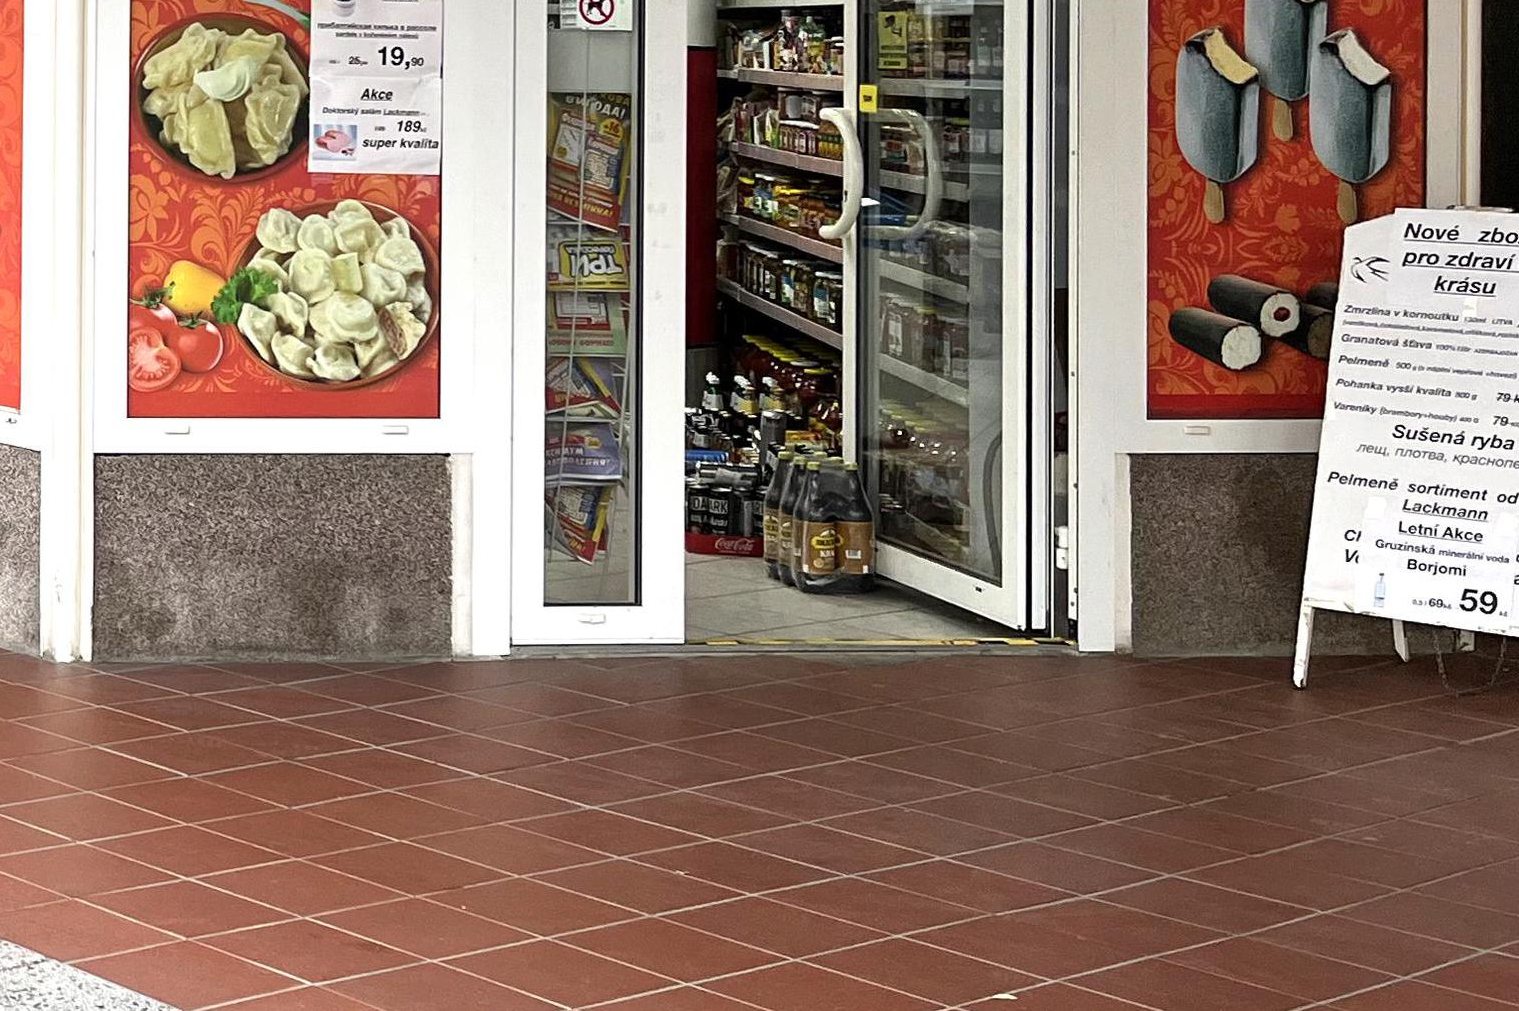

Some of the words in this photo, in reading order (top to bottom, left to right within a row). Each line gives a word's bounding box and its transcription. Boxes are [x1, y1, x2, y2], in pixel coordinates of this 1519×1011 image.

[378, 46, 425, 70] 19,90
[361, 88, 393, 101] Akce
[362, 139, 397, 151] super
[400, 138, 439, 149] kvalita
[1404, 223, 1459, 241] Nové
[1478, 227, 1519, 244] zbo
[1402, 251, 1439, 268] pro
[1445, 252, 1515, 270] zdraví
[1434, 276, 1496, 295] krásu
[1344, 305, 1391, 316] Zmrzlina
[1402, 309, 1459, 321] kornoutku
[1338, 355, 1389, 368] Pelmeně
[1335, 378, 1383, 391] Pohanka
[1416, 386, 1452, 397] kvalita
[1392, 424, 1466, 446] Sušená
[1471, 434, 1515, 451] ryba
[1327, 471, 1399, 490] Pelmeně
[1408, 482, 1488, 501] sortiment
[1403, 499, 1489, 520] Lackmann
[1398, 521, 1439, 536] Letní
[1443, 527, 1484, 542] Akce
[1438, 548, 1484, 560] minerální
[1486, 552, 1510, 563] voda
[1407, 558, 1467, 576] Borjomi
[1459, 588, 1498, 615] 59
